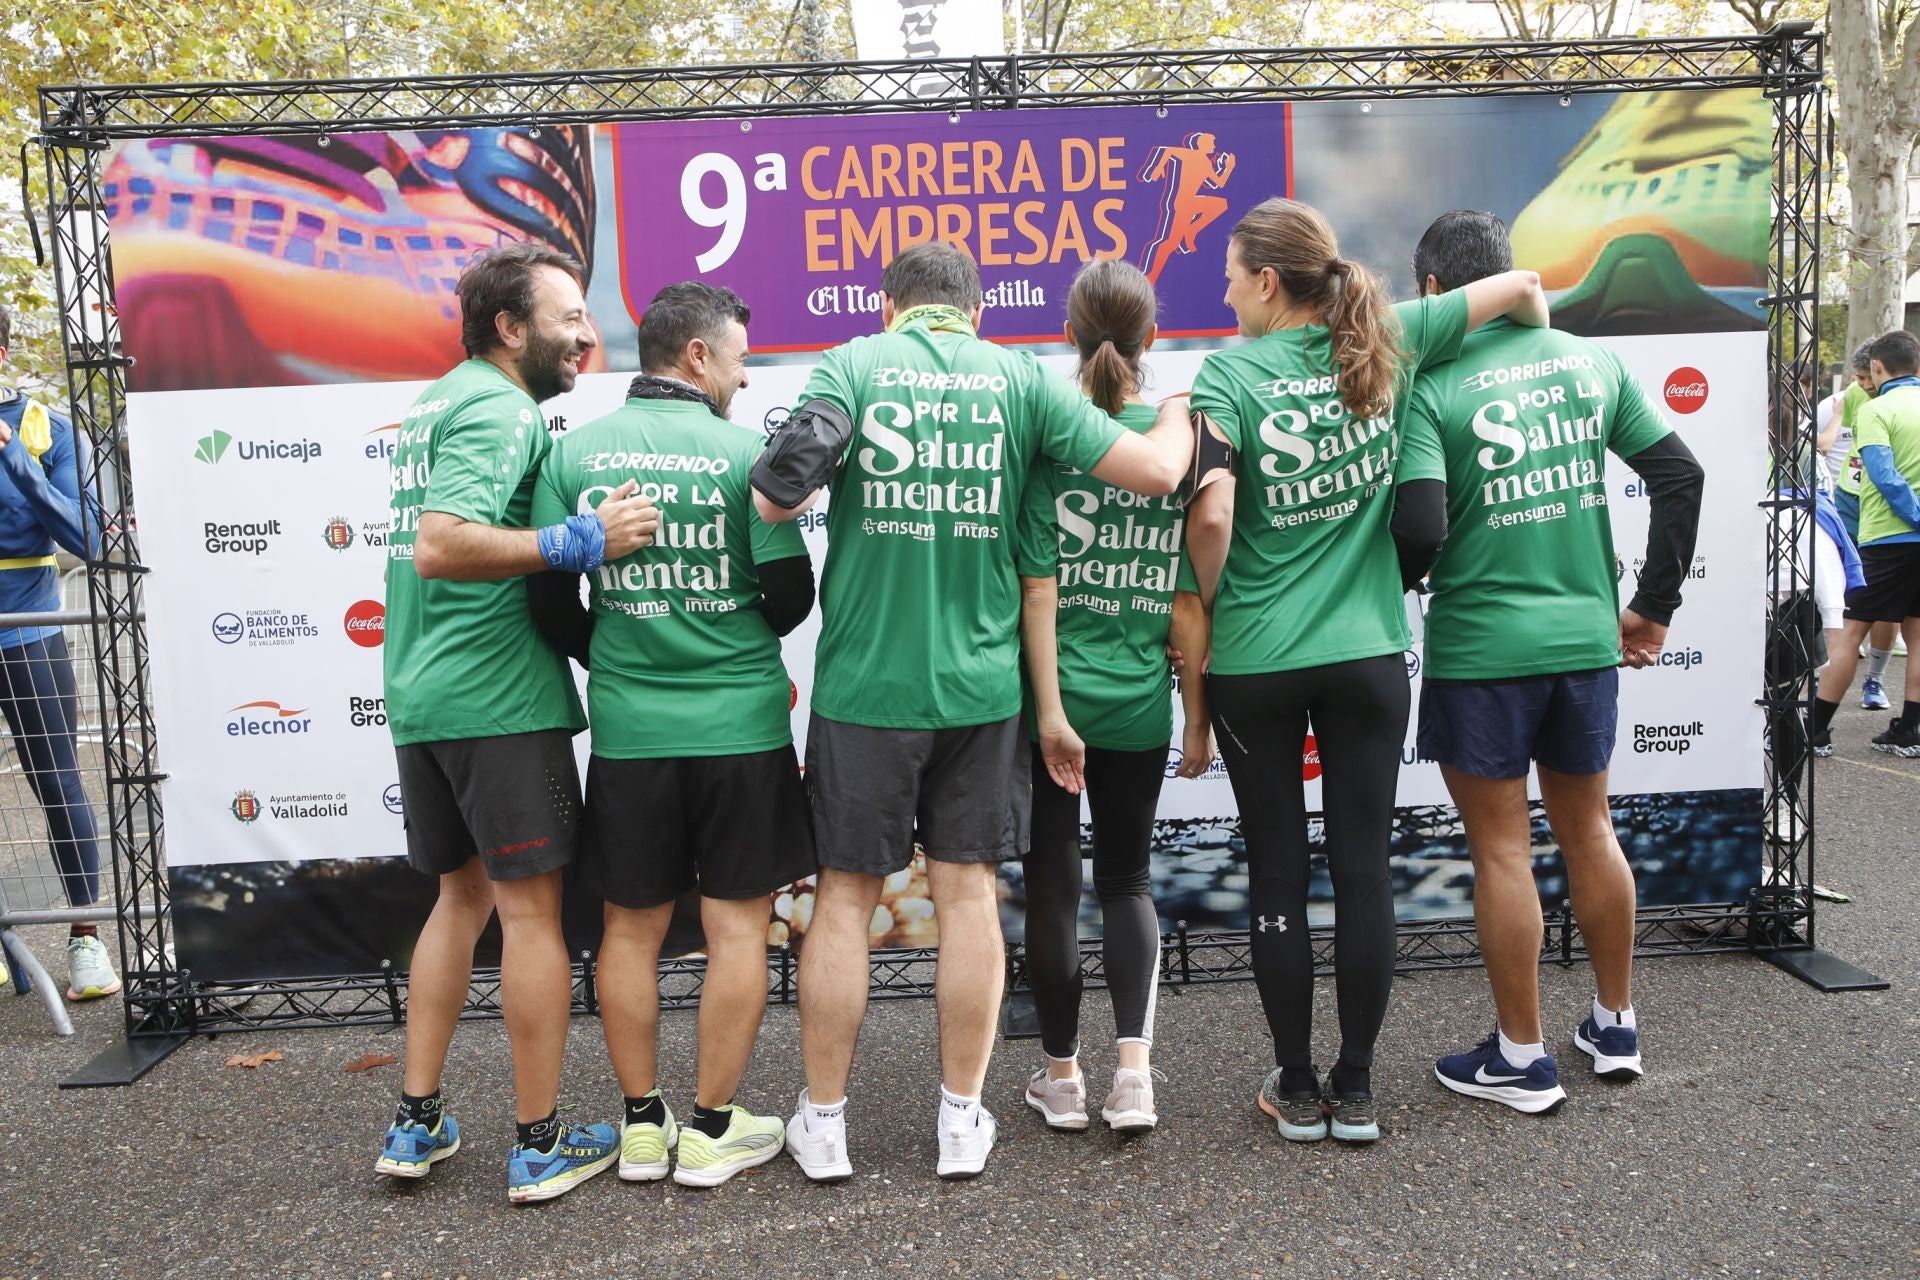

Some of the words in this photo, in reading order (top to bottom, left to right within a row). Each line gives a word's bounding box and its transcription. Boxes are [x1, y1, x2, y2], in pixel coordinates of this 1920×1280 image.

[801, 138, 1046, 200] CARRERA
[1060, 137, 1127, 191] DE
[805, 199, 1128, 272] EMPRESAS
[1477, 355, 1595, 389] CORRIENDO
[1517, 385, 1568, 411] POR
[1575, 379, 1604, 399] LA
[1665, 383, 1707, 398] Coca-Cola
[971, 403, 1005, 426] LA
[1309, 399, 1353, 424] PO
[858, 401, 1005, 477] Salud
[1472, 399, 1606, 471] Salud
[238, 438, 323, 463] Unicaja
[592, 452, 730, 475] CORRIENDO
[1481, 453, 1606, 507] menta
[624, 482, 679, 504] POR
[691, 485, 727, 507] LA
[861, 476, 1002, 515] mental
[1288, 498, 1359, 526] ensuma
[1502, 502, 1567, 527] ensuma
[204, 519, 282, 538] Renault
[1055, 489, 1184, 559] Salud
[205, 537, 268, 556] Group
[685, 597, 738, 613] intras
[246, 616, 289, 628] BANCO
[292, 614, 309, 626] DE
[248, 626, 319, 640] ALIMENTOS
[258, 638, 295, 647] VALLADOLID
[226, 717, 312, 736] elecnor
[350, 712, 387, 727] Gro
[1634, 721, 1704, 739] Renault
[1633, 738, 1691, 756] Group
[270, 793, 333, 804] Ayuntamiento
[335, 792, 347, 801] de
[270, 803, 348, 820] Valladolid
